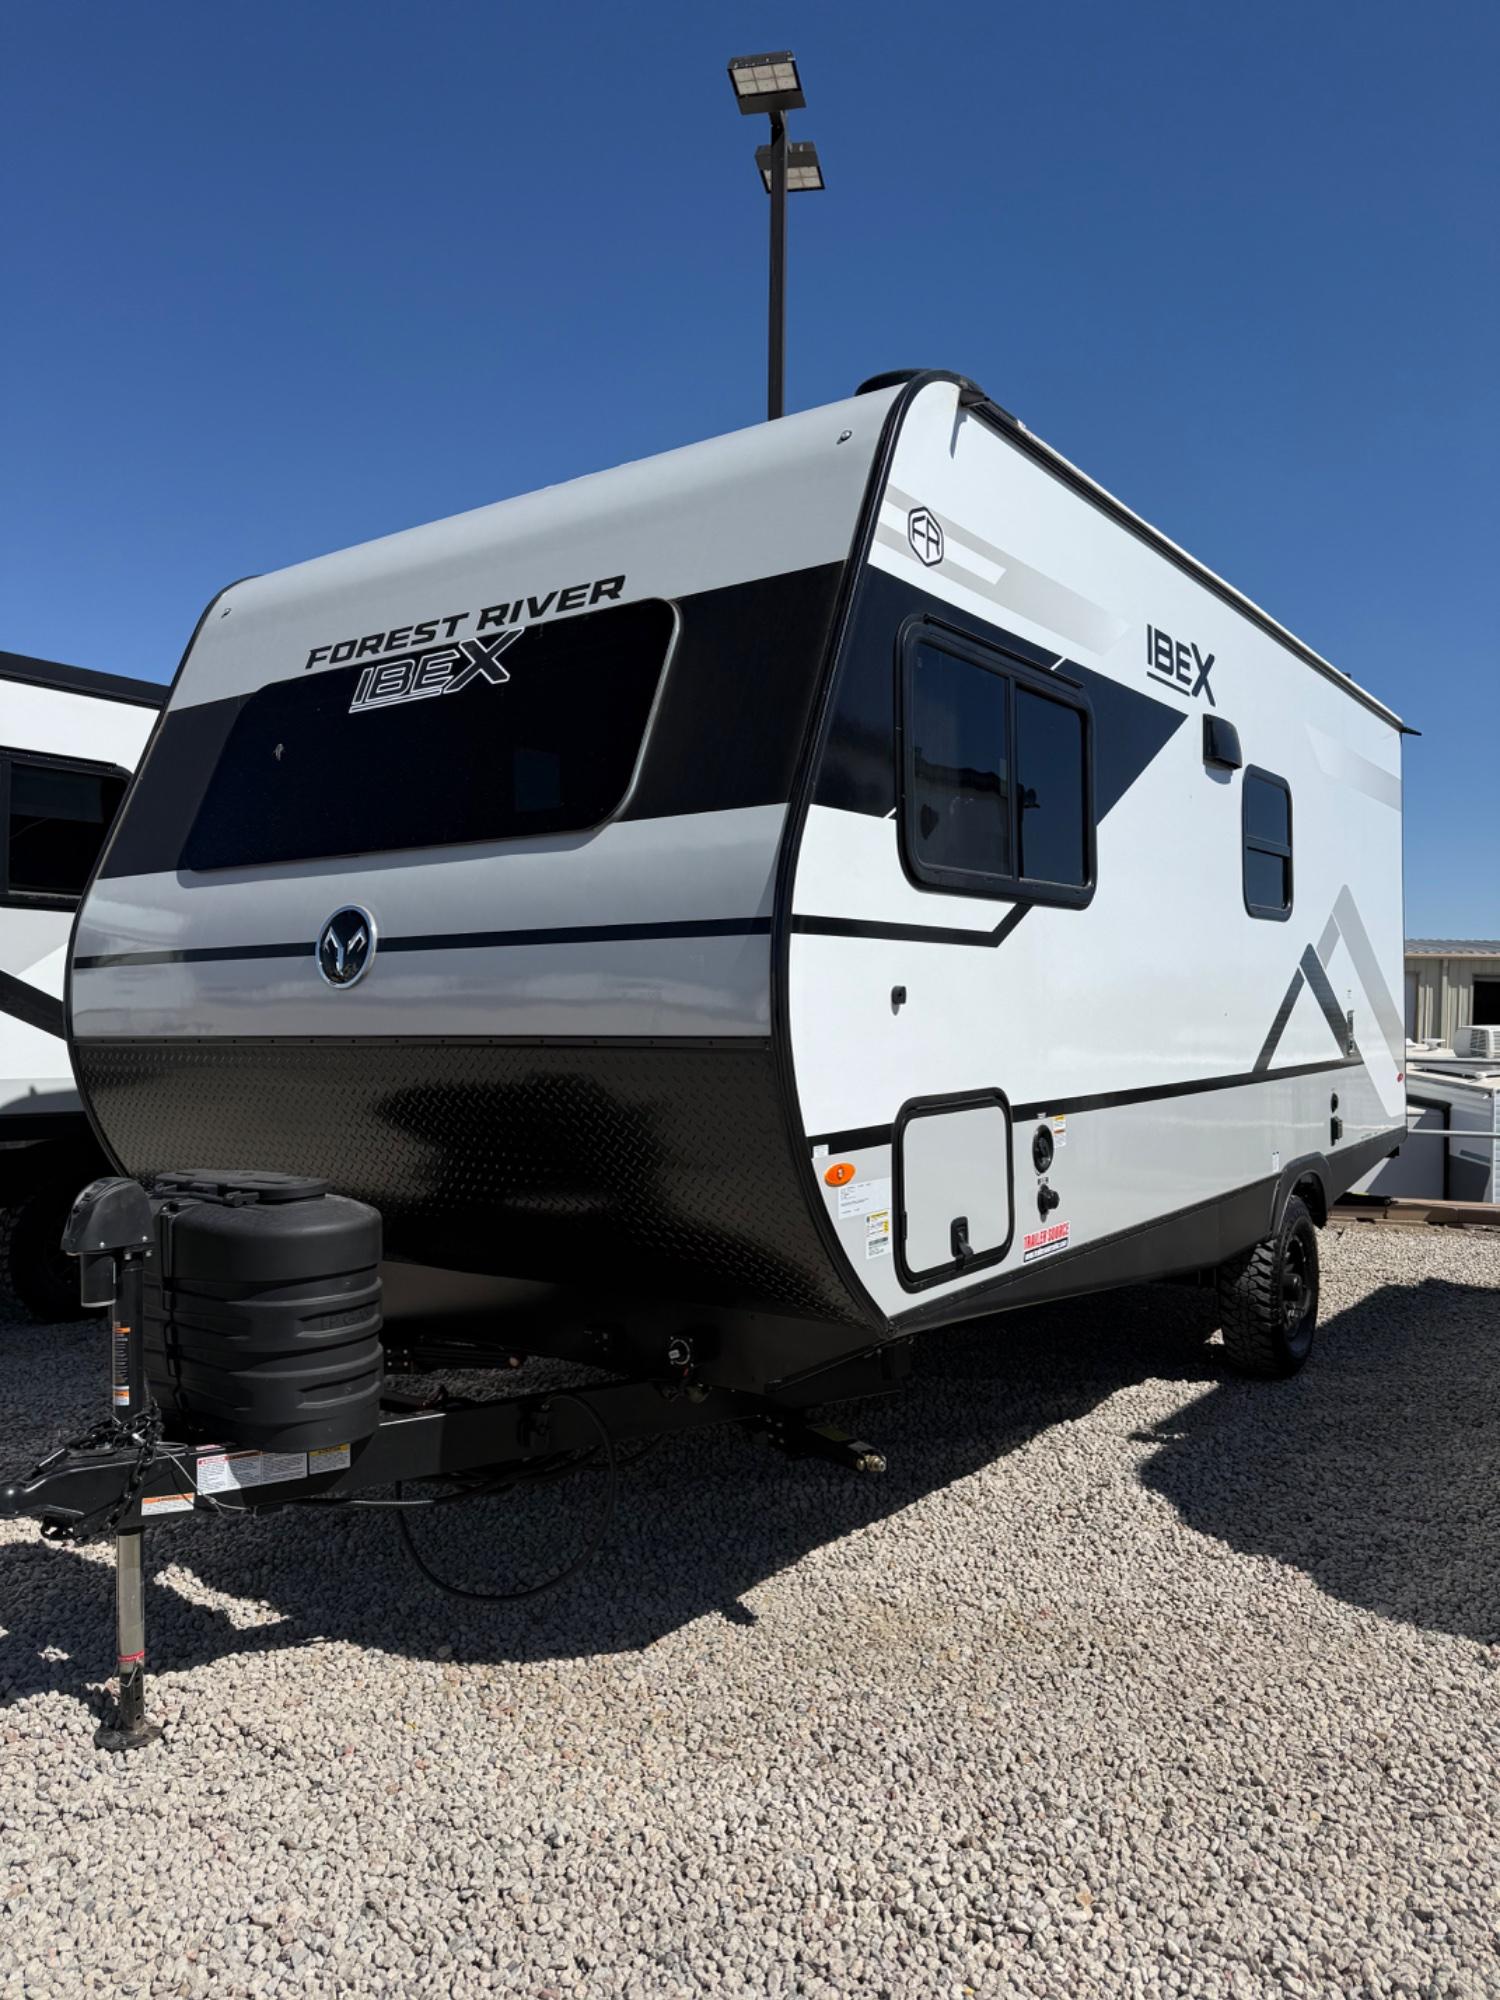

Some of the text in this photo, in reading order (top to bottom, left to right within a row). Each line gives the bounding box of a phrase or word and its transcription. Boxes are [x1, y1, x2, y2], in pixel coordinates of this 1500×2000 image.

[305, 574, 626, 669] FOREST RIVER
[350, 627, 525, 709] IBEX
[1147, 624, 1216, 707] IBEX
[1023, 1230, 1047, 1250] TRAILER
[1048, 1221, 1070, 1242] SOURCE
